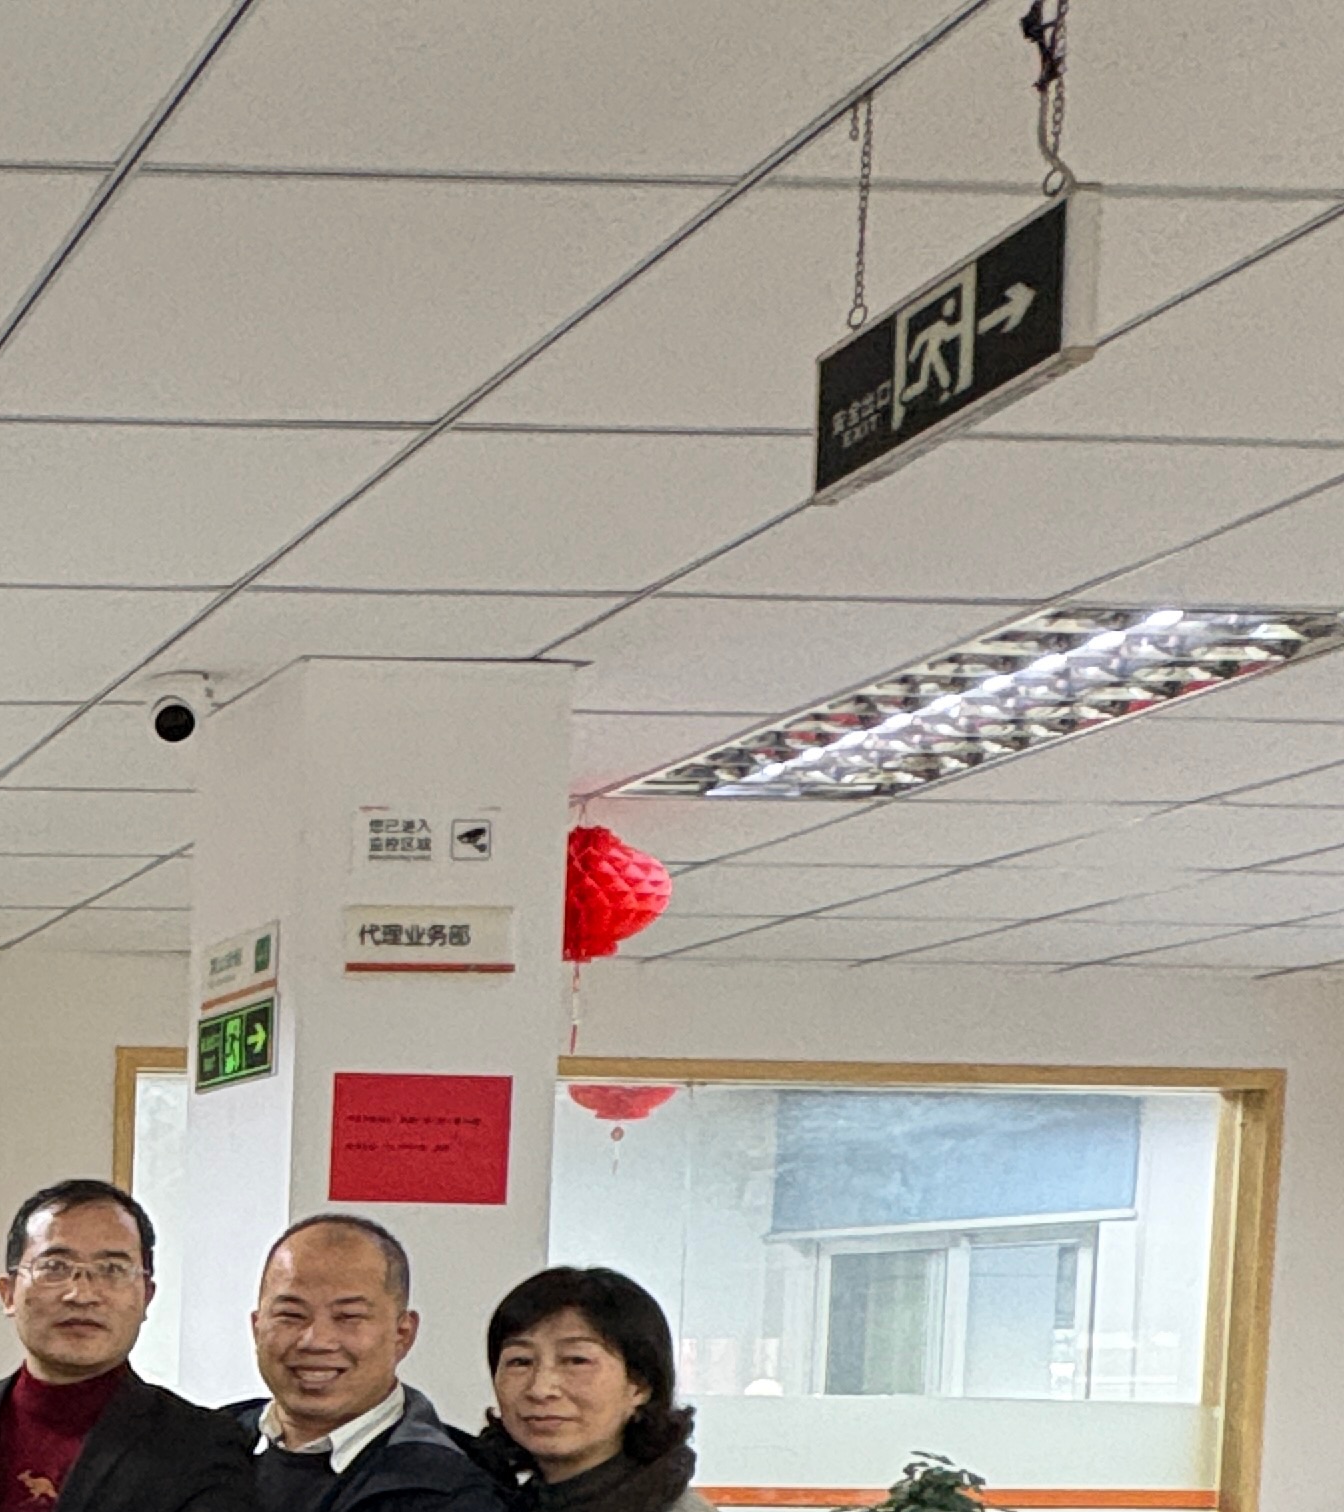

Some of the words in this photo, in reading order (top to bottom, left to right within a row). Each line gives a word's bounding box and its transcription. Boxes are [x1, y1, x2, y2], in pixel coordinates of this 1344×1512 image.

[843, 412, 882, 448] EXIT
[369, 837, 432, 852] 监控区域
[359, 924, 472, 947] 代理业务部
